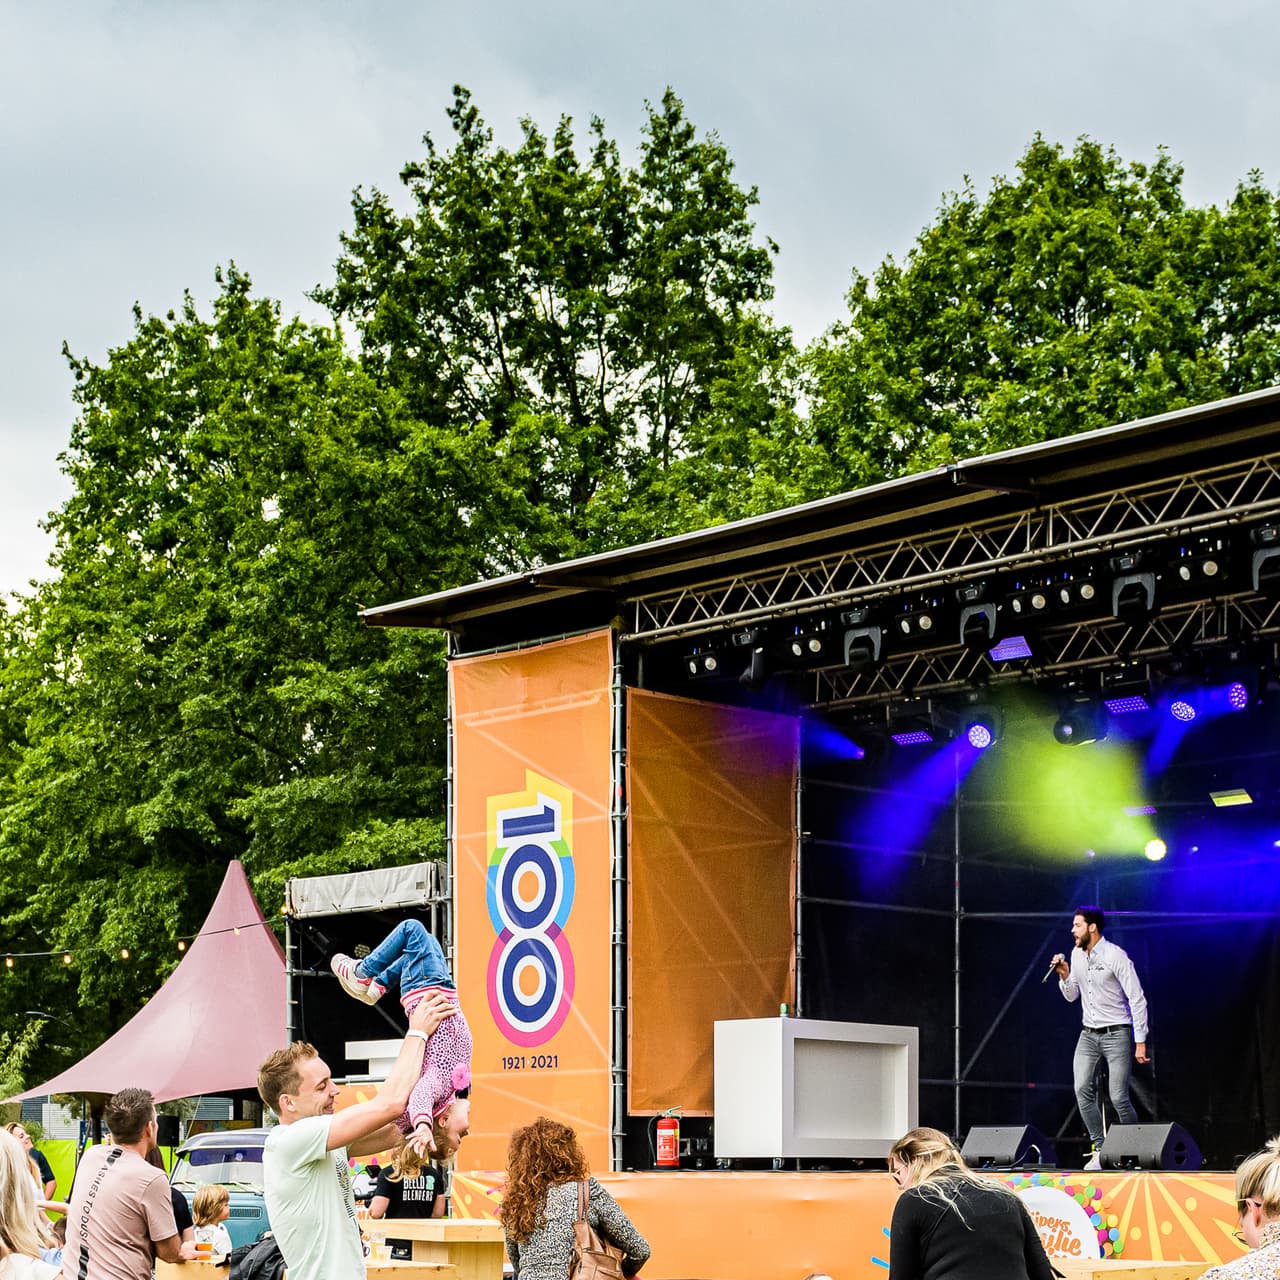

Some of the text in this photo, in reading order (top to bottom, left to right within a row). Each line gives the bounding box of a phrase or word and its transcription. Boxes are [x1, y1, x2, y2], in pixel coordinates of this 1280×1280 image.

[495, 791, 564, 1033] 100
[502, 1055, 558, 1070] 1921 2021
